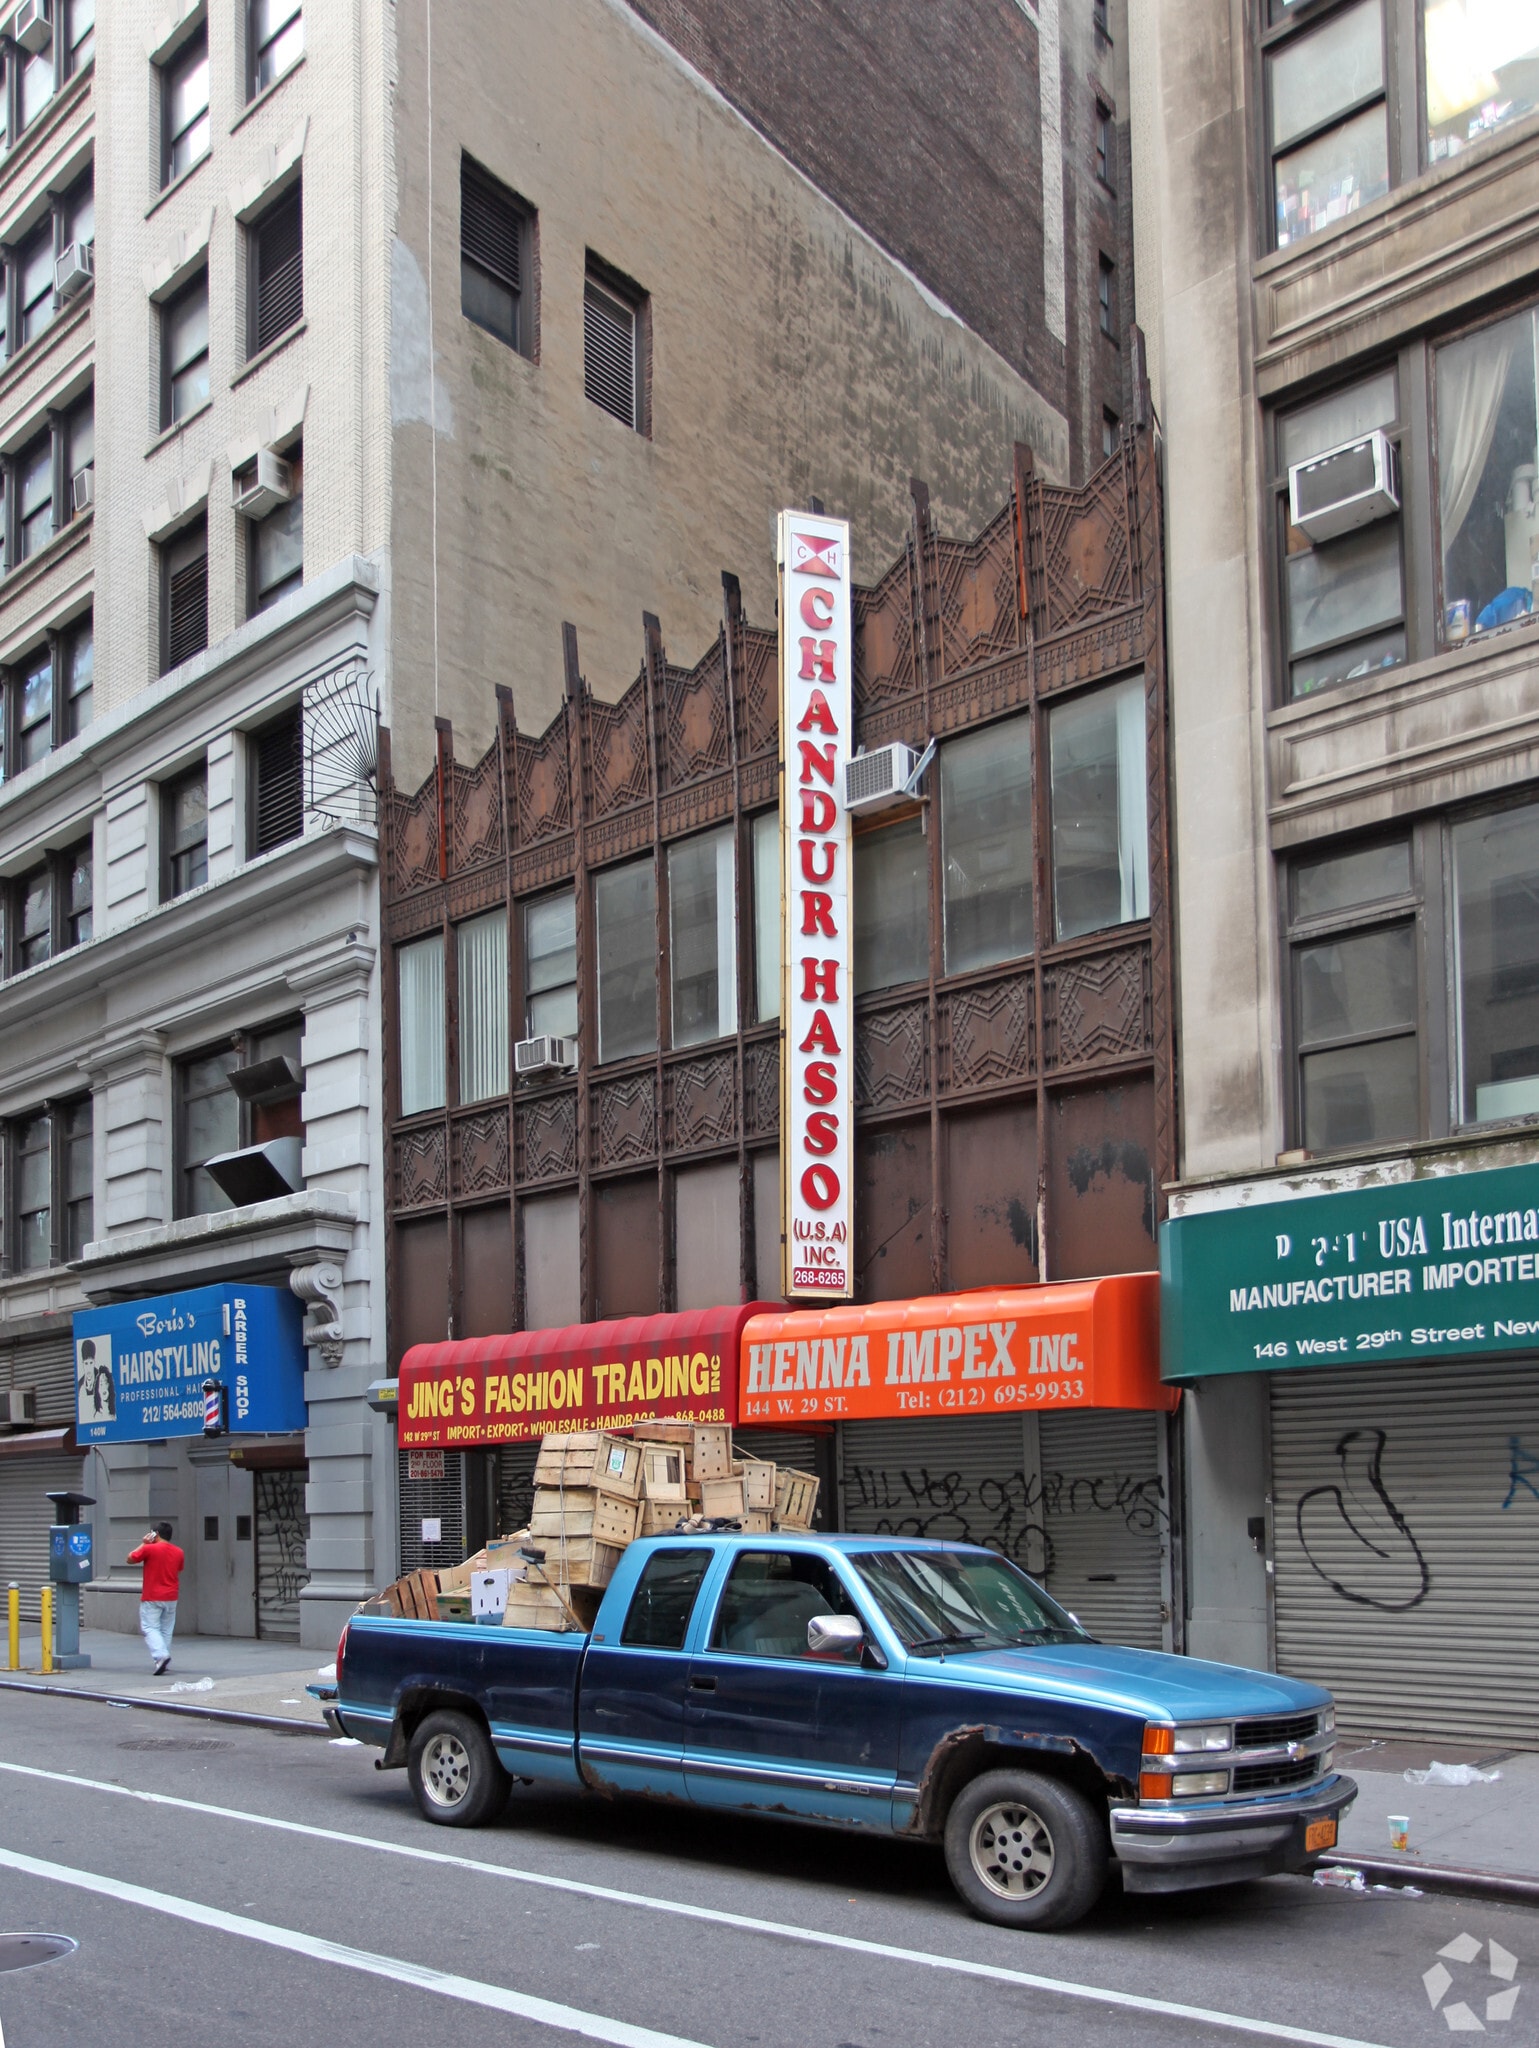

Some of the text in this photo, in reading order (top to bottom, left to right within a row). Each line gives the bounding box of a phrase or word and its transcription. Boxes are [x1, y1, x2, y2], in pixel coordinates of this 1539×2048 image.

[797, 545, 837, 566] C H
[798, 587, 842, 1211] CHANDUR HASSO
[1378, 1216, 1428, 1259] USA
[1441, 1208, 1539, 1251] Interna
[803, 1245, 841, 1267] INC.
[794, 1270, 845, 1286] 268-6265
[1229, 1253, 1539, 1312] MANUFACTURER IMPORTE
[136, 1307, 197, 1339] Boris's
[746, 1321, 1084, 1393] HENNA IMPEX INC.
[1253, 1341, 1288, 1359] 146
[1296, 1337, 1348, 1355] West
[1356, 1329, 1402, 1349] 29th
[1410, 1324, 1485, 1345] Street
[119, 1339, 221, 1386] HAIRSTYLING
[234, 1298, 250, 1419] BARBER SHOP
[710, 1354, 721, 1393] INC
[120, 1385, 180, 1403] PROFESSIONAL
[407, 1352, 710, 1420] JING'S FASHION TRADING
[896, 1379, 1085, 1409] Tel: (212) 695-9933
[163, 1400, 205, 1421] 564-6809
[746, 1396, 849, 1416] 144 W. 29 ST.
[403, 1431, 413, 1442] 142
[432, 1430, 441, 1441] ST
[410, 1451, 443, 1459] FOR RENT
[422, 1460, 443, 1469] FLOOR
